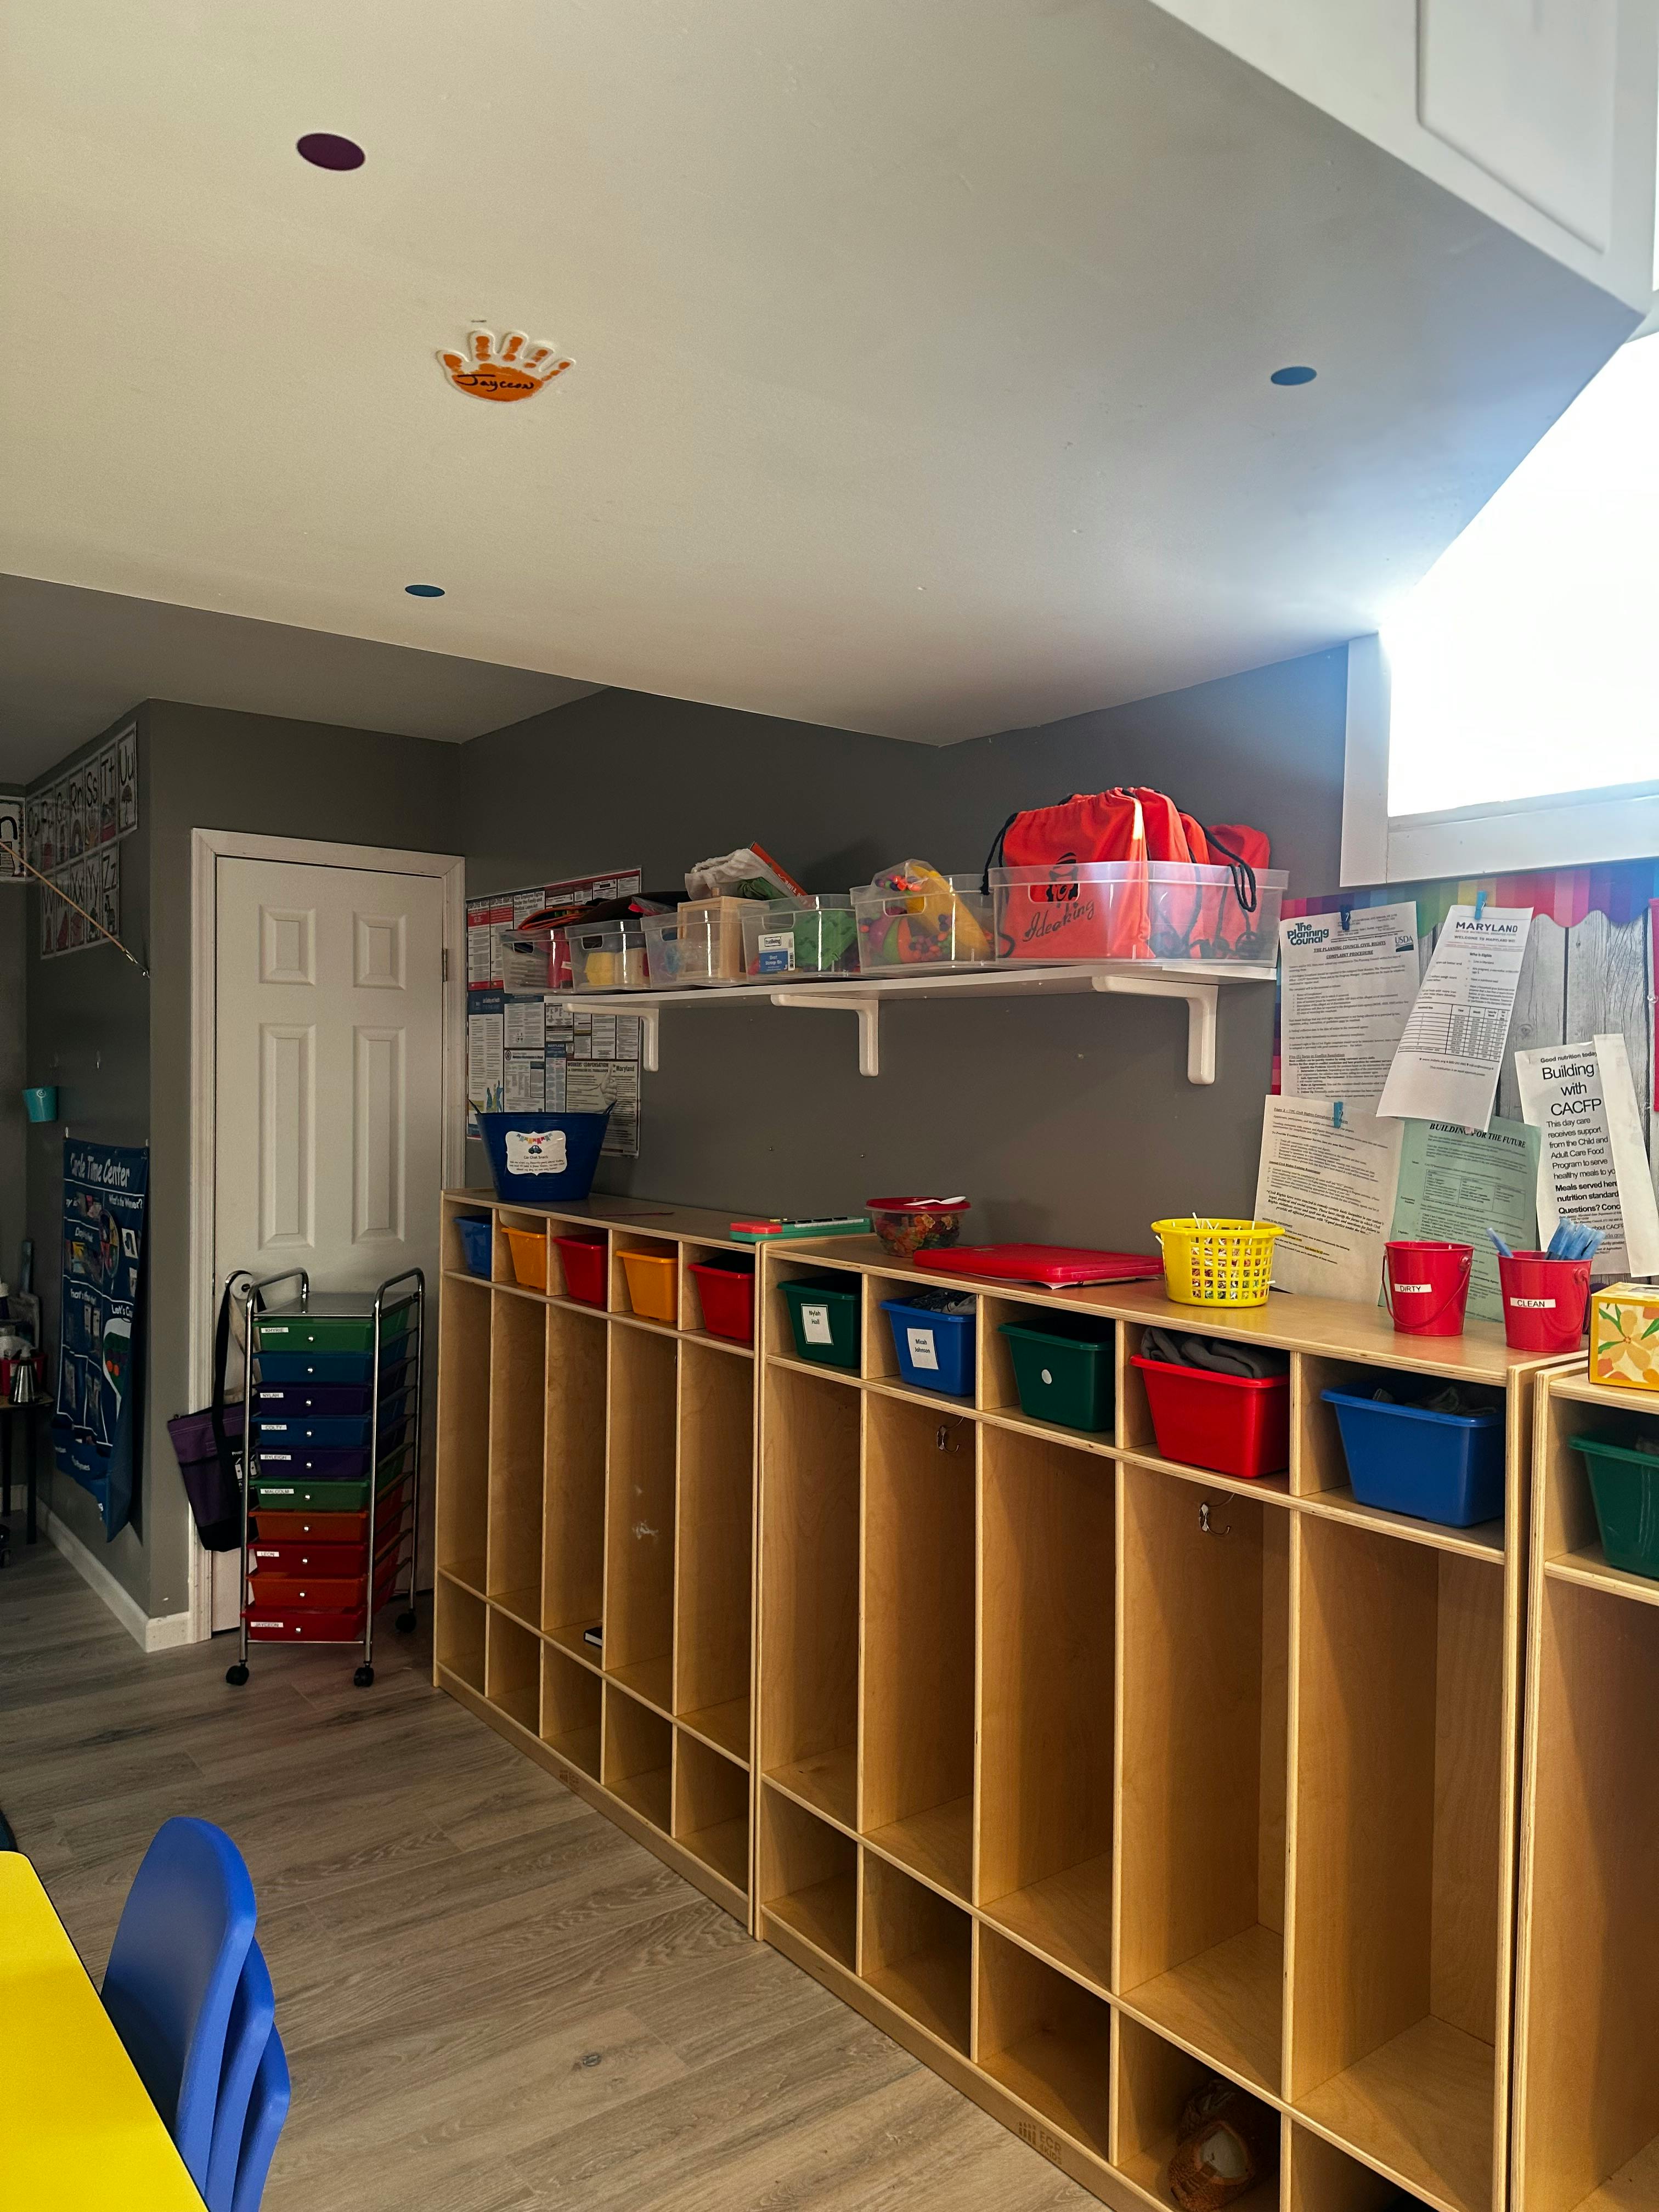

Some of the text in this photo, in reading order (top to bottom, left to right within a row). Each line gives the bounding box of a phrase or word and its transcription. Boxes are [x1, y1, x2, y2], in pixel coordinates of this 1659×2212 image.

[120, 747, 134, 786] Uu
[87, 771, 97, 806] Ss
[104, 855, 116, 893] Zz
[1023, 901, 1094, 942] Ideaking
[1295, 922, 1312, 932] The
[1456, 922, 1518, 933] MARYLAND
[1287, 929, 1329, 939] Planning
[1290, 934, 1323, 946] Council
[1395, 935, 1413, 944] USDA
[1542, 1063, 1594, 1080] Building
[1560, 1082, 1587, 1096] with
[1551, 1098, 1601, 1116] CACFP
[1548, 1126, 1601, 1138] receives support
[1471, 1129, 1487, 1139] FOR
[1488, 1133, 1502, 1142] THE
[1503, 1136, 1526, 1148] FUTURE
[1578, 1137, 1594, 1146] Child
[1551, 1150, 1568, 1159] Adult
[87, 1154, 103, 1183] Time
[103, 1158, 130, 1187] Center
[1552, 1161, 1582, 1170] Program
[1554, 1171, 1578, 1180] healthy
[1555, 1184, 1577, 1192] Meals
[1578, 1181, 1602, 1189] served
[1558, 1204, 1600, 1215] Questions?
[1517, 1299, 1545, 1308] CLEAN
[1040, 2130, 1062, 2155] ECR
